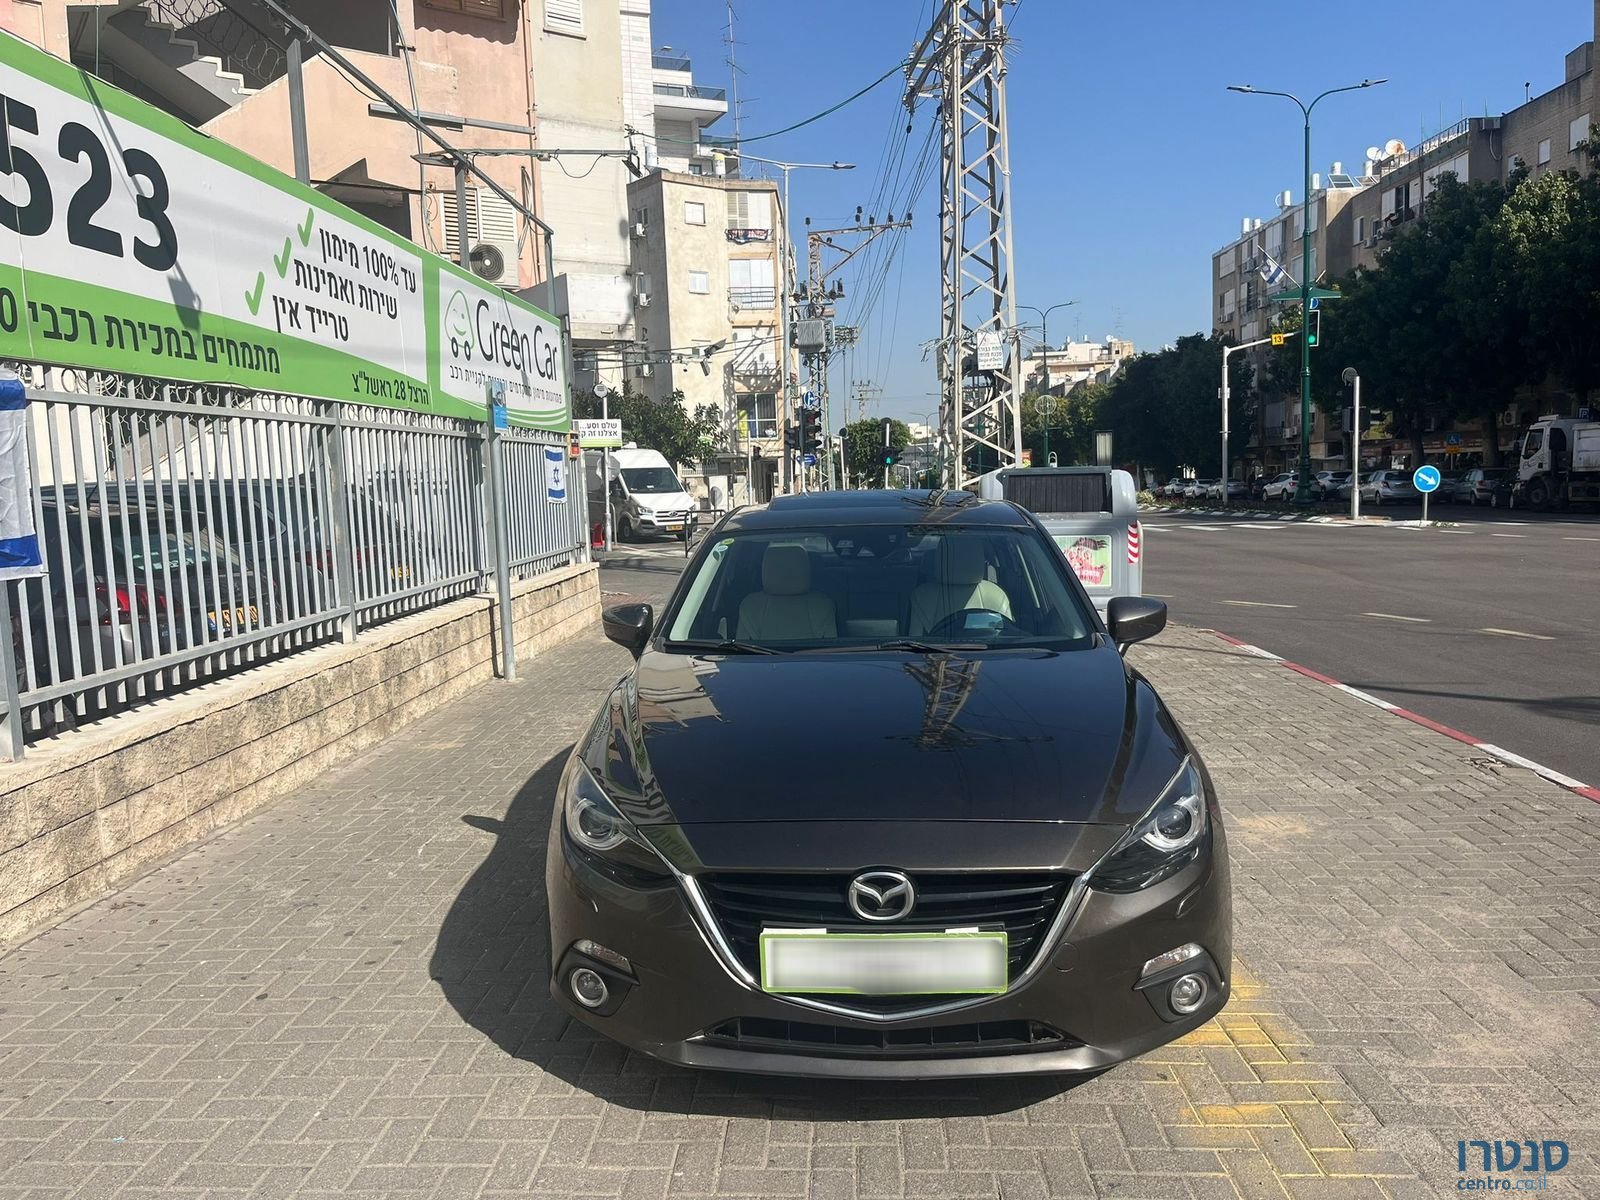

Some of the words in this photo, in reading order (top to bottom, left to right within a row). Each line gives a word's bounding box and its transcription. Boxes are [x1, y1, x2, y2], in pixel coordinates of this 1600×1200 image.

[0, 93, 178, 271] 523
[319, 228, 360, 269] מימון
[363, 245, 399, 286] 100%
[294, 259, 355, 305] ואמינות
[401, 267, 416, 293] עד
[272, 295, 301, 333] אין
[358, 284, 397, 320] שירות
[27, 301, 97, 345] רכבי
[104, 315, 198, 361] במכירת
[305, 305, 349, 341] טרייד
[476, 299, 532, 374] Green
[533, 324, 558, 381] Car
[1274, 335, 1282, 343] 13
[202, 334, 281, 374] מתמחים
[449, 365, 463, 380] רכב
[394, 379, 406, 400] 28
[407, 381, 429, 405] הרצל
[465, 370, 486, 389] לקניית
